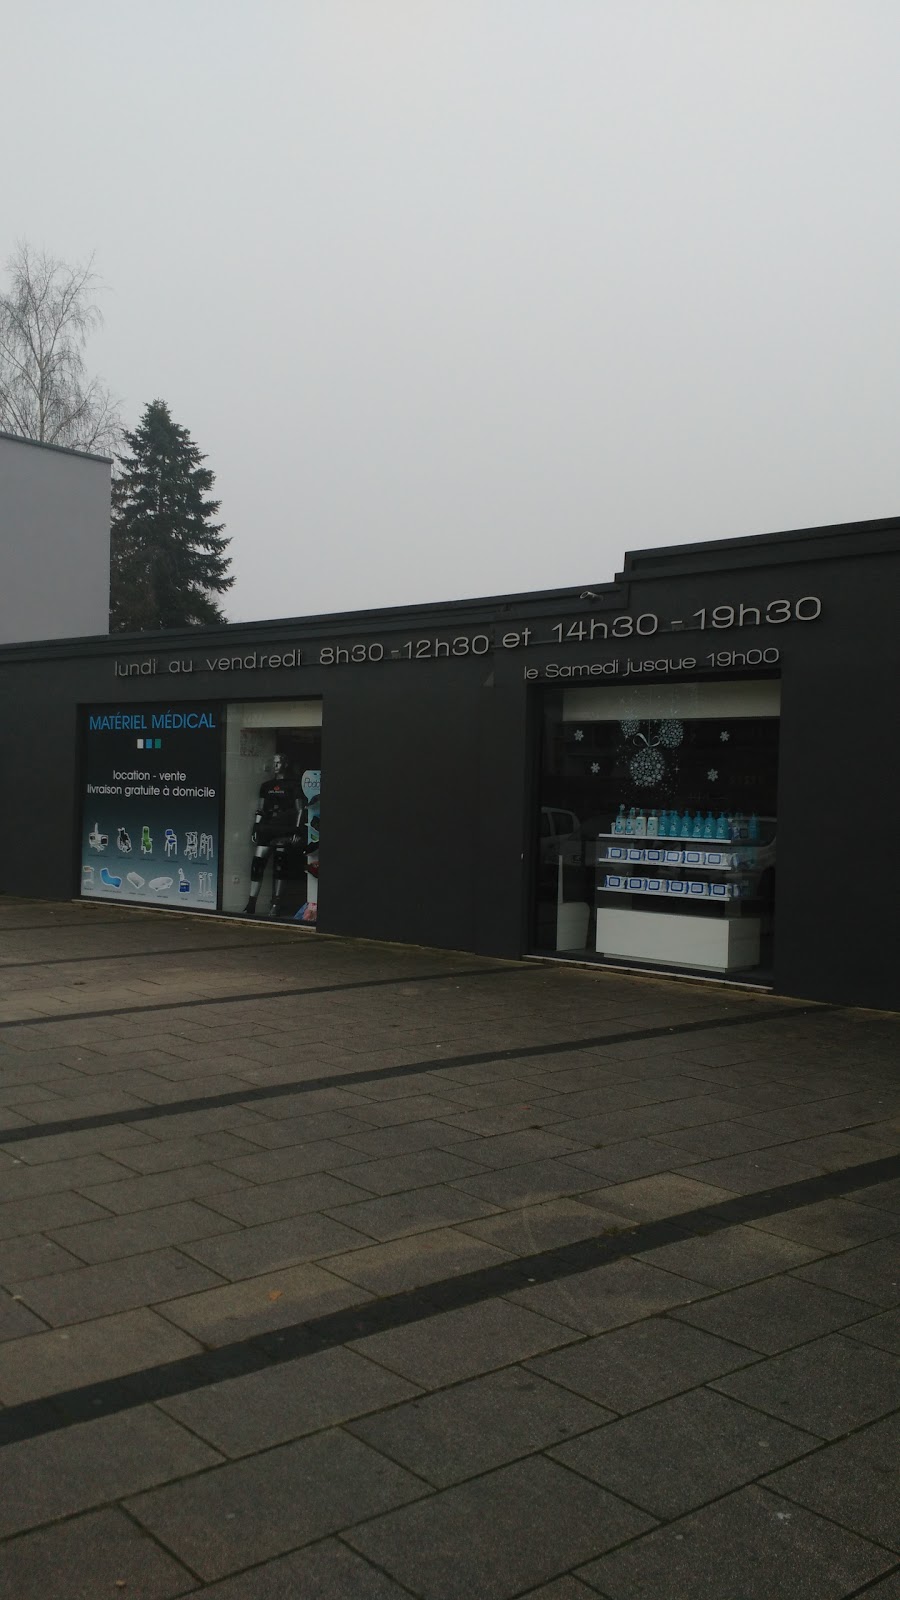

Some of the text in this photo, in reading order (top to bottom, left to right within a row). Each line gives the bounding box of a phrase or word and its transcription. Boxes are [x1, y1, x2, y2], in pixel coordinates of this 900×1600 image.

[114, 659, 157, 677] lundi
[168, 659, 193, 673] au
[206, 649, 302, 671] vendredi
[319, 643, 384, 665] 8h30
[403, 634, 489, 659] 12h30
[502, 627, 531, 648] et
[552, 613, 659, 643] 14h30
[693, 596, 822, 630] 19h30
[524, 647, 780, 680] le Samedi jusque 19h00
[89, 709, 216, 730] MATÉRIEL MÉDICAL
[112, 770, 151, 781] location
[159, 772, 187, 782] vente
[86, 784, 216, 798] livraison gratuite à domicile
